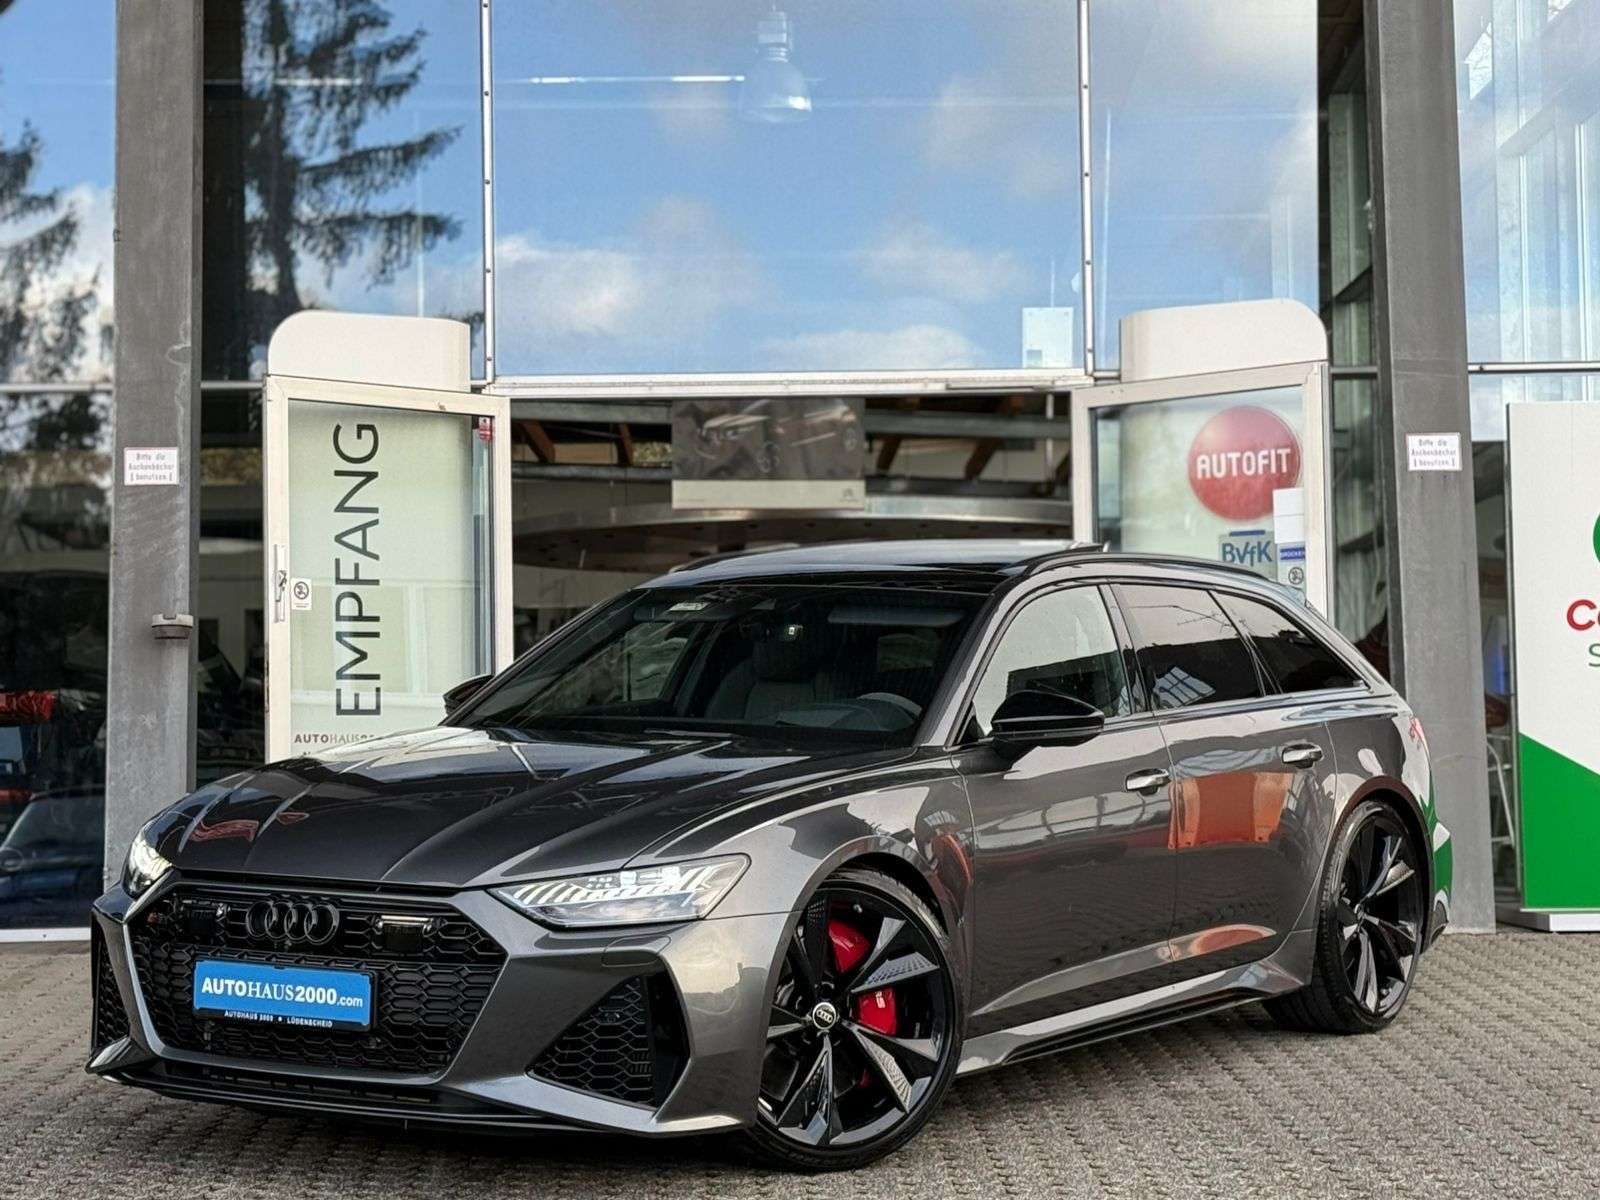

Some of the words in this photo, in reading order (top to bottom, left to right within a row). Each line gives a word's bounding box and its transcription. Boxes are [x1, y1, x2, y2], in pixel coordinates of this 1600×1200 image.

[1196, 448, 1291, 479] AUTOFIT
[333, 423, 381, 715] EMPFANG
[1566, 599, 1600, 631] C
[201, 977, 363, 1008] AUTOHAUS2000.com
[224, 1010, 258, 1021] AUTOHAUS
